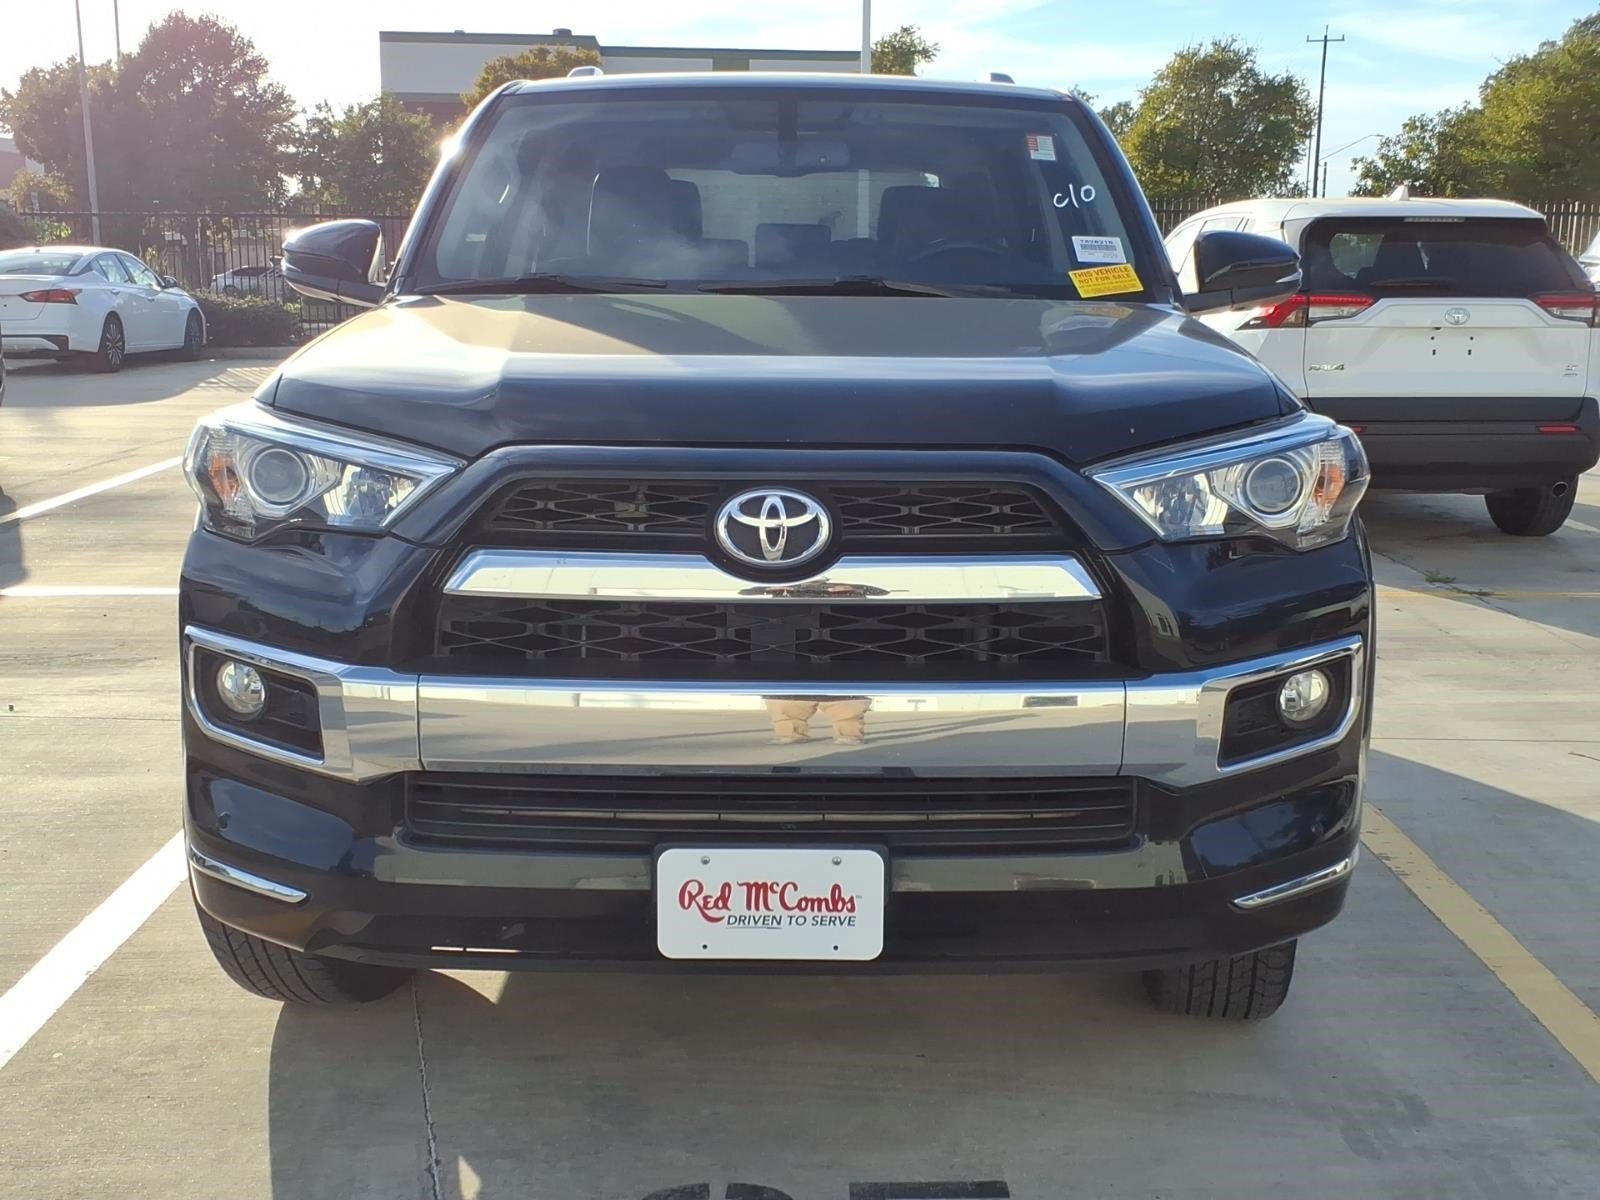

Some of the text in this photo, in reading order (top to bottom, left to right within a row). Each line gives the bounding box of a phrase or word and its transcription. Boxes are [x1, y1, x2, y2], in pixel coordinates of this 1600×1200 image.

[1072, 265, 1130, 278] THIS VEHICLE
[1078, 276, 1094, 284] NOT
[1112, 272, 1131, 280] SALE
[678, 879, 857, 923] Red McCombs
[726, 914, 857, 927] DRIVEN TO SERVE
